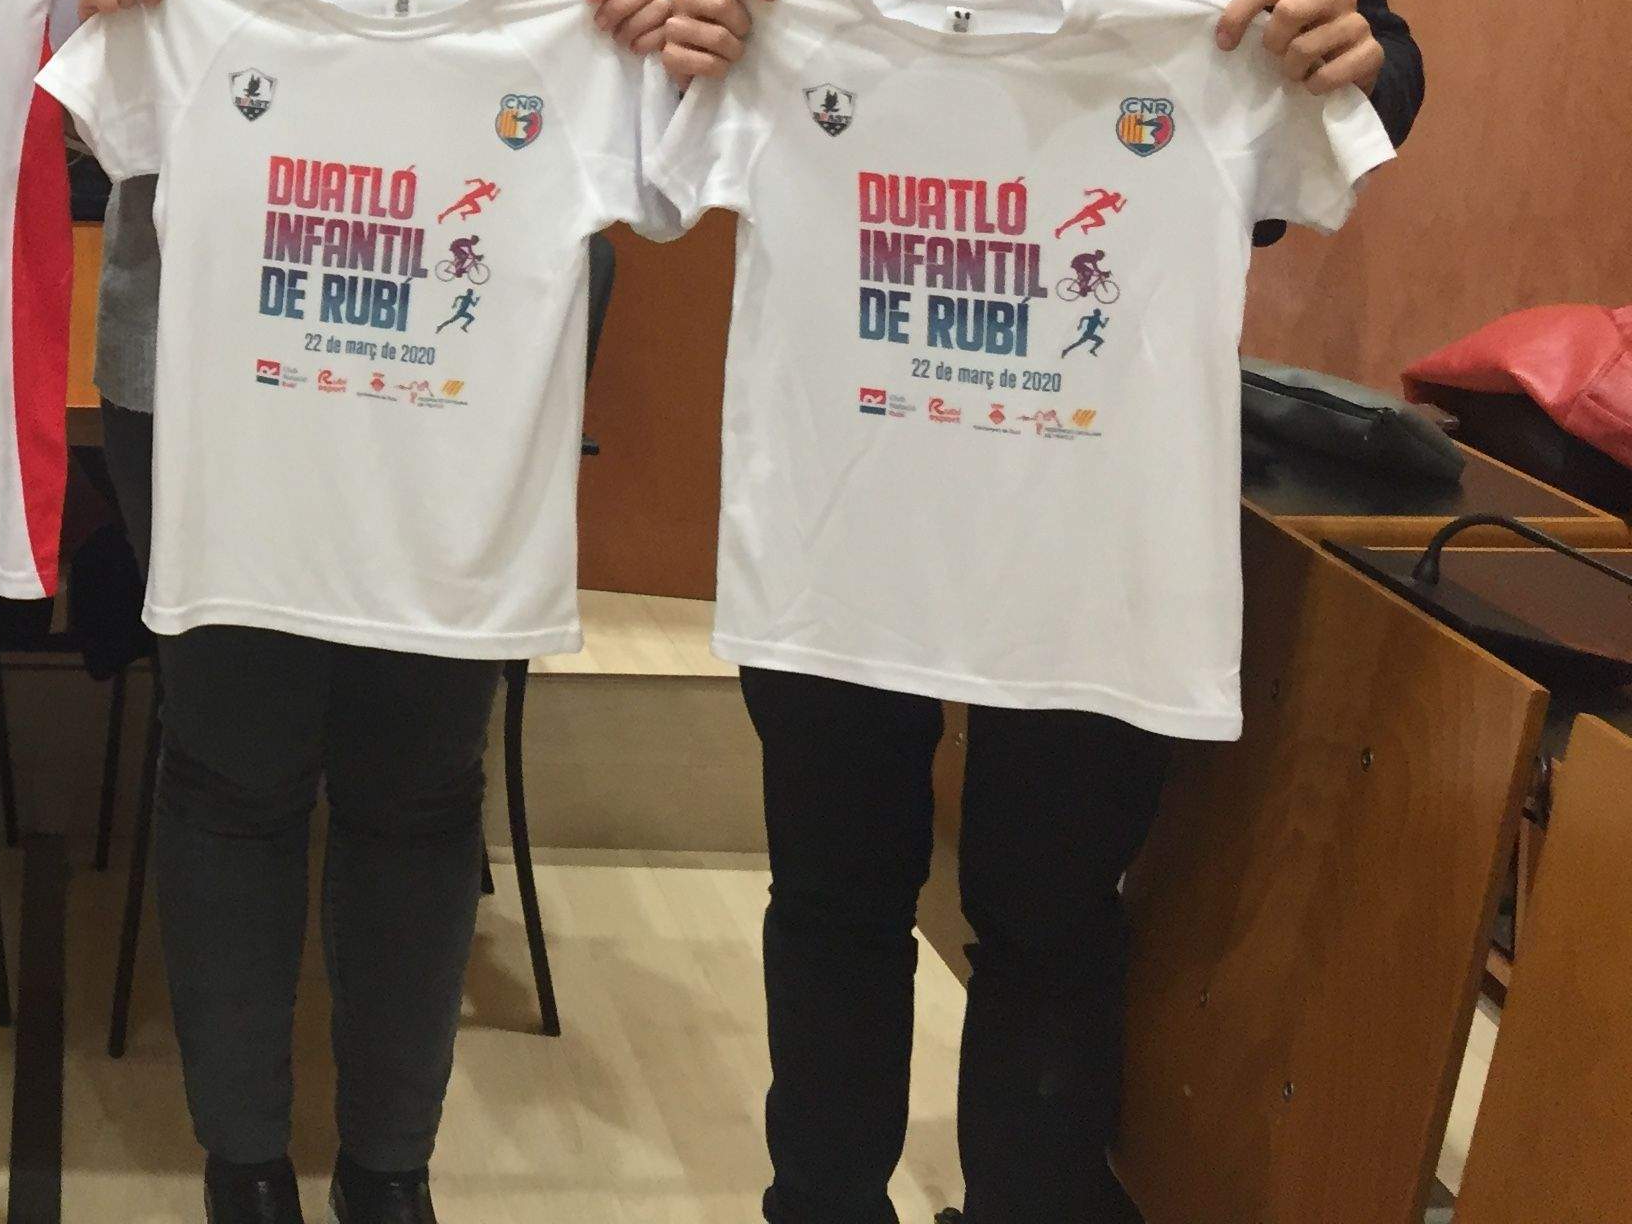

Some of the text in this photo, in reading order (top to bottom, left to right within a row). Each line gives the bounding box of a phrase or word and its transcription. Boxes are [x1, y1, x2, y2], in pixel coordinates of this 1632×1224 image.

[1126, 101, 1168, 114] CNR
[268, 156, 417, 220] DUATLÓ
[859, 171, 1027, 236] DUATLÓ
[263, 210, 429, 278] INFANTIL
[860, 229, 1048, 298] INFANTIL
[259, 266, 413, 332] DE RUBÍ
[859, 287, 1031, 357] DE RUBÍ
[304, 333, 436, 366] 22 de març de 2020
[911, 358, 1062, 393] 22 de març de 2020
